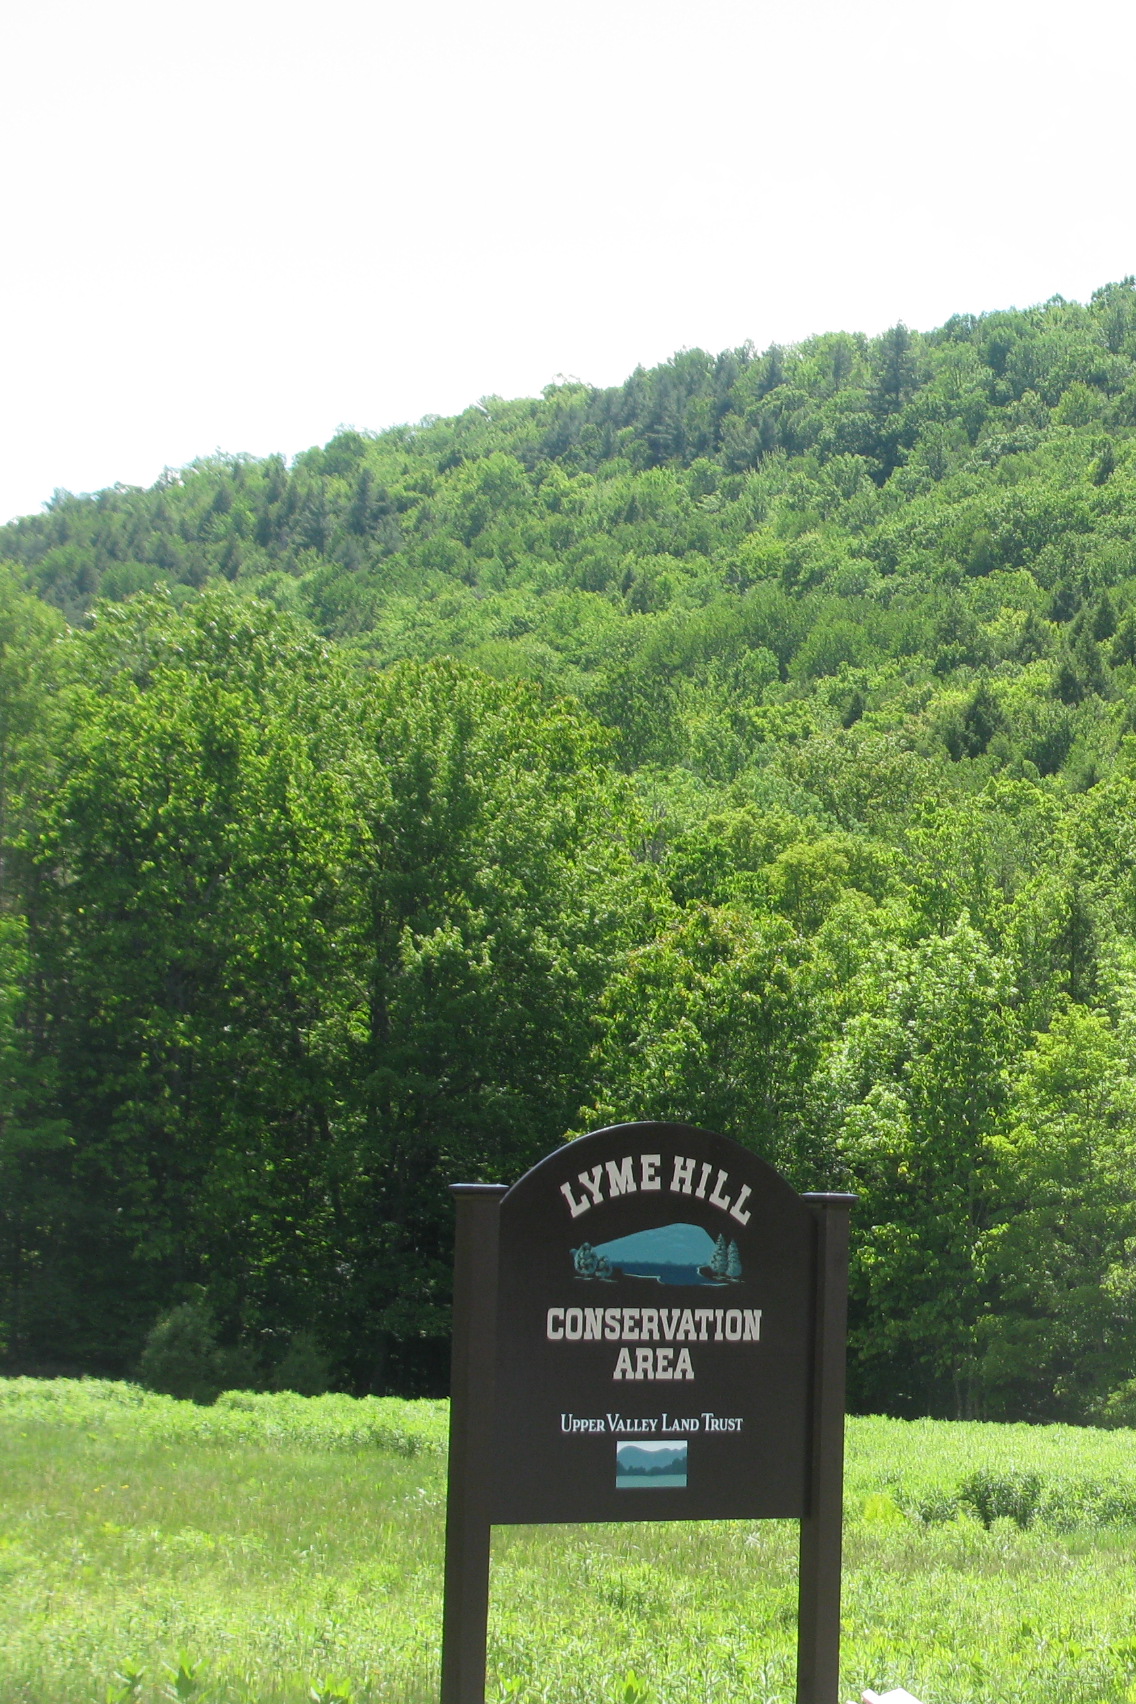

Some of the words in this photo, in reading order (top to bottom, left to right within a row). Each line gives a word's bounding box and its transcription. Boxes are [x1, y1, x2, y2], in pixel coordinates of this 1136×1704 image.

[560, 1154, 661, 1218] LYME
[670, 1155, 752, 1226] HILL
[546, 1307, 762, 1341] CONSERVATION
[613, 1347, 695, 1380] AREA
